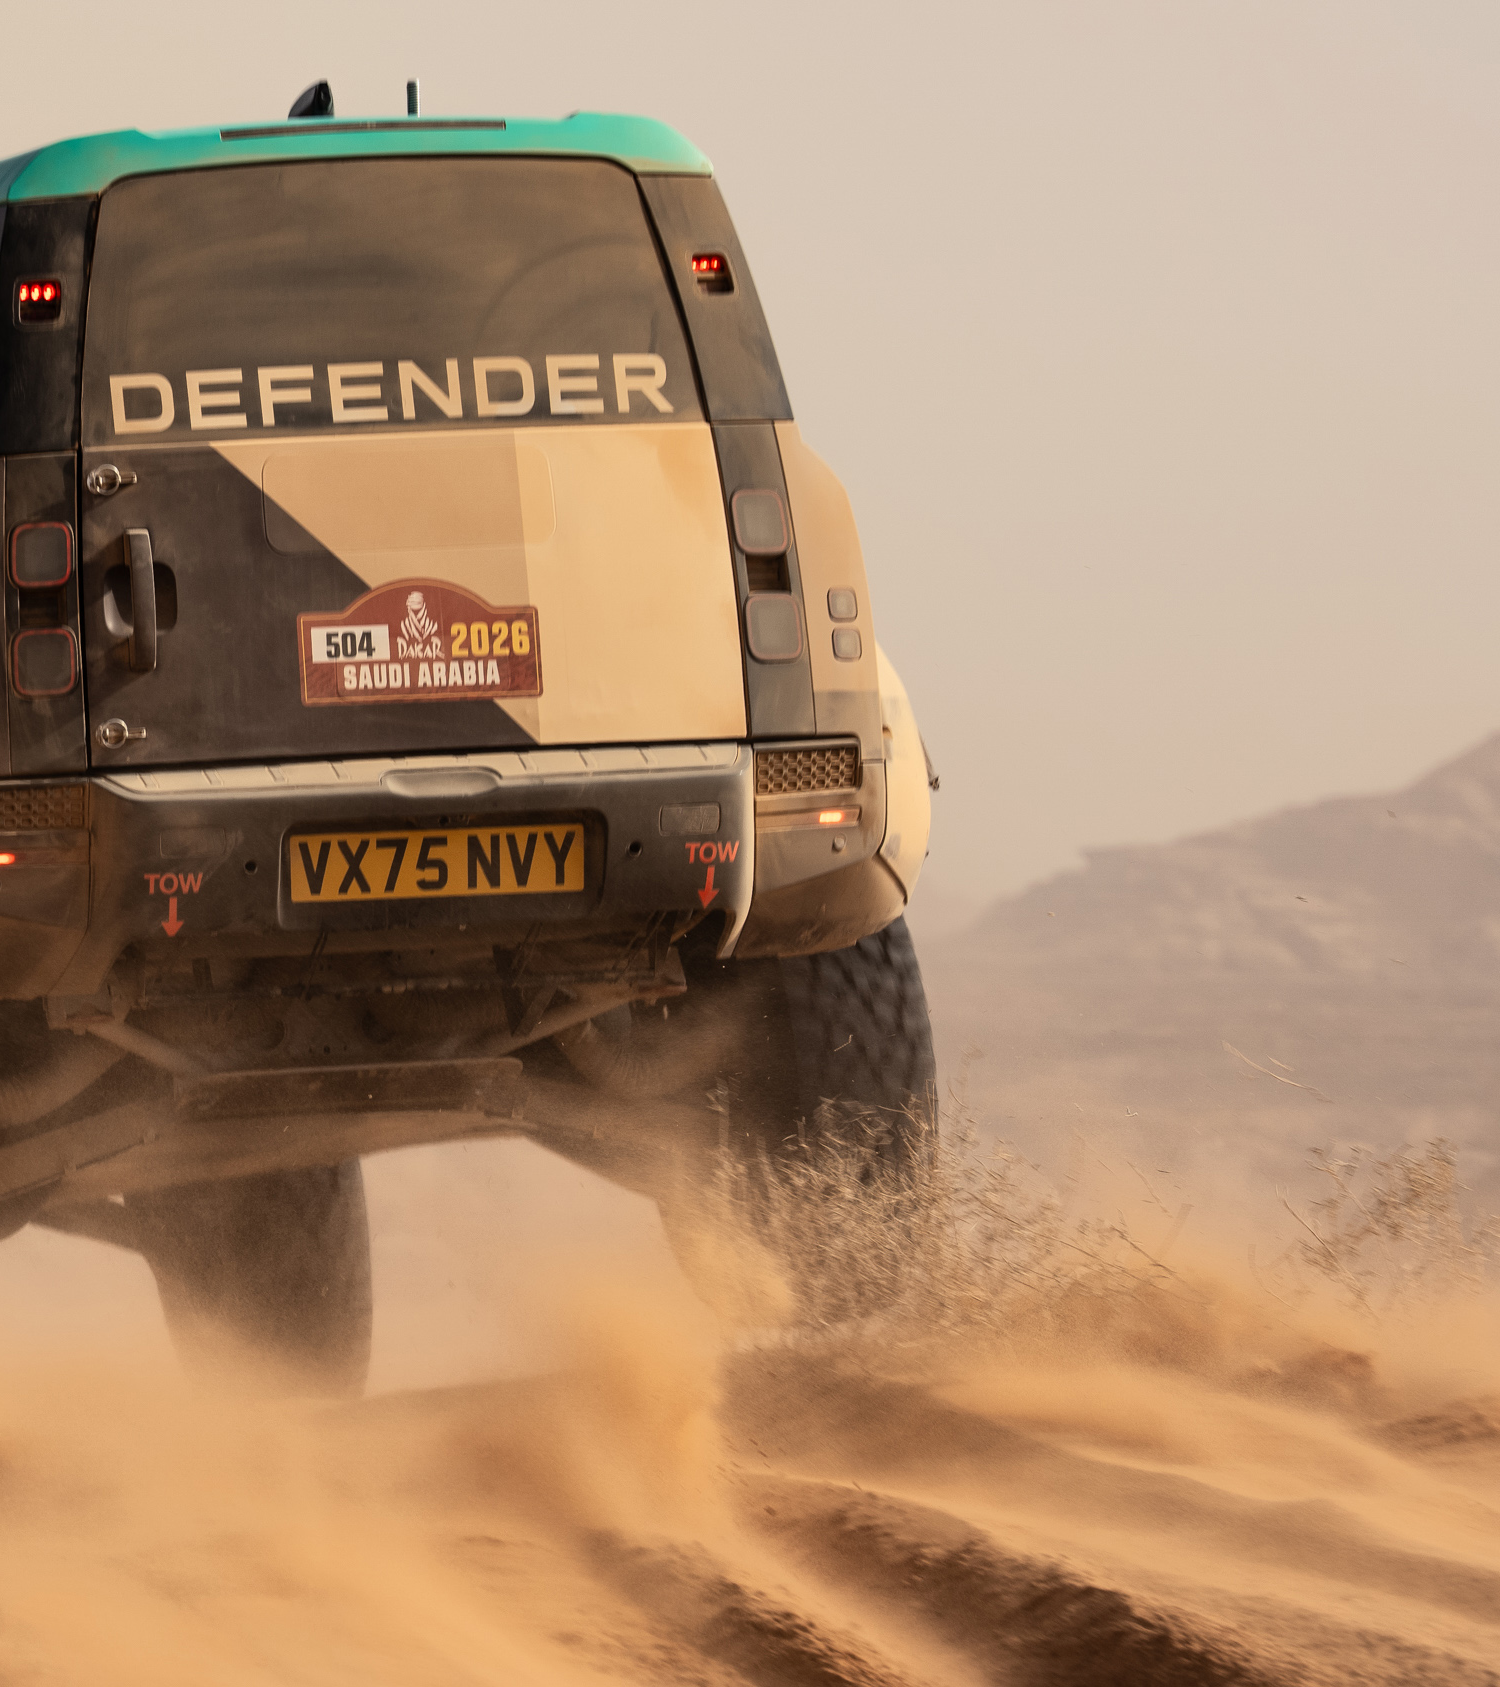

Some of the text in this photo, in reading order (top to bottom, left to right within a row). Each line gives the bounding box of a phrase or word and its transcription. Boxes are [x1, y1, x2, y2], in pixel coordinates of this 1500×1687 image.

[109, 353, 674, 435] DEFENDER
[326, 630, 375, 659] 504
[396, 636, 445, 660] DAKAR
[451, 620, 530, 658] 2026
[343, 659, 500, 690] SAUDI ARABIA
[298, 831, 576, 896] VX75 NVY
[685, 841, 740, 864] TOW
[143, 872, 203, 895] TOW
